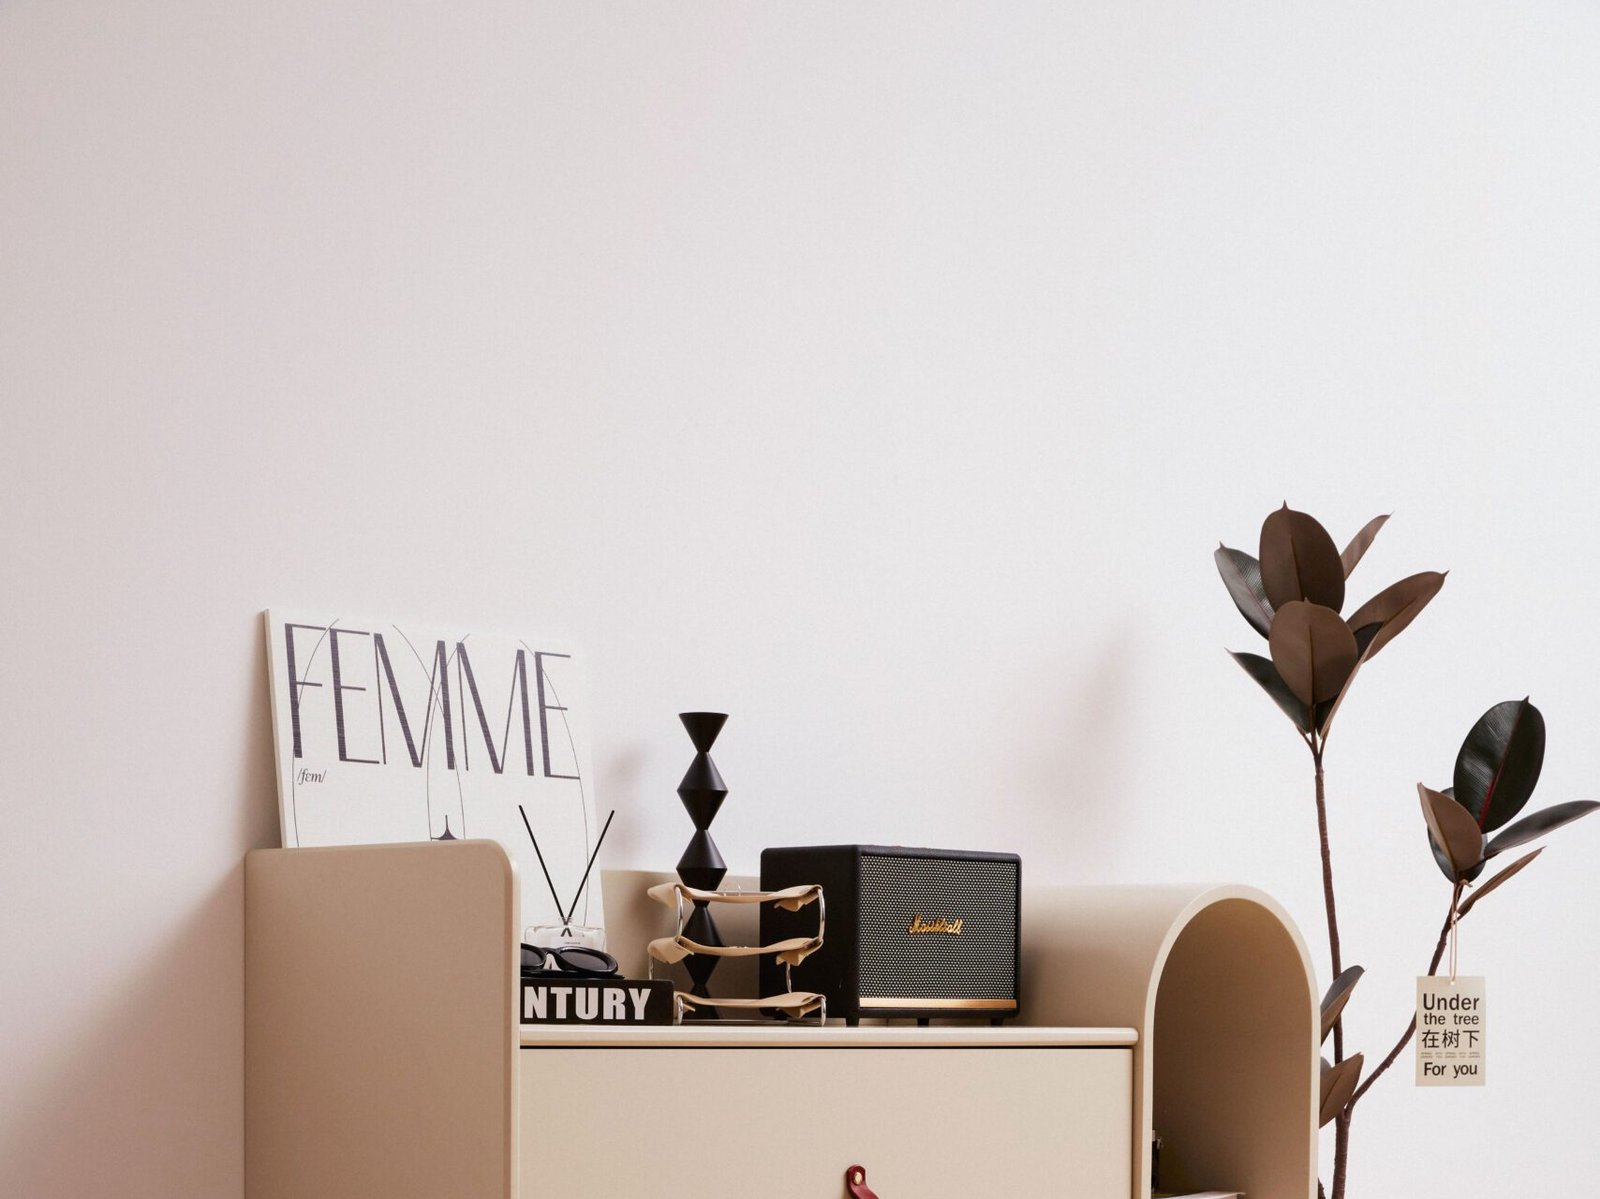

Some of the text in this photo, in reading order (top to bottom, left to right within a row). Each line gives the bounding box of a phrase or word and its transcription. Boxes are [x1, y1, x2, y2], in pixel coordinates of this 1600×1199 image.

[285, 622, 581, 780] FEMME
[524, 986, 652, 1020] NTURY
[1423, 993, 1479, 1011] Under
[1423, 1012, 1479, 1025] the tree
[1421, 1029, 1480, 1048] 在树下
[1424, 1062, 1478, 1079] For you
